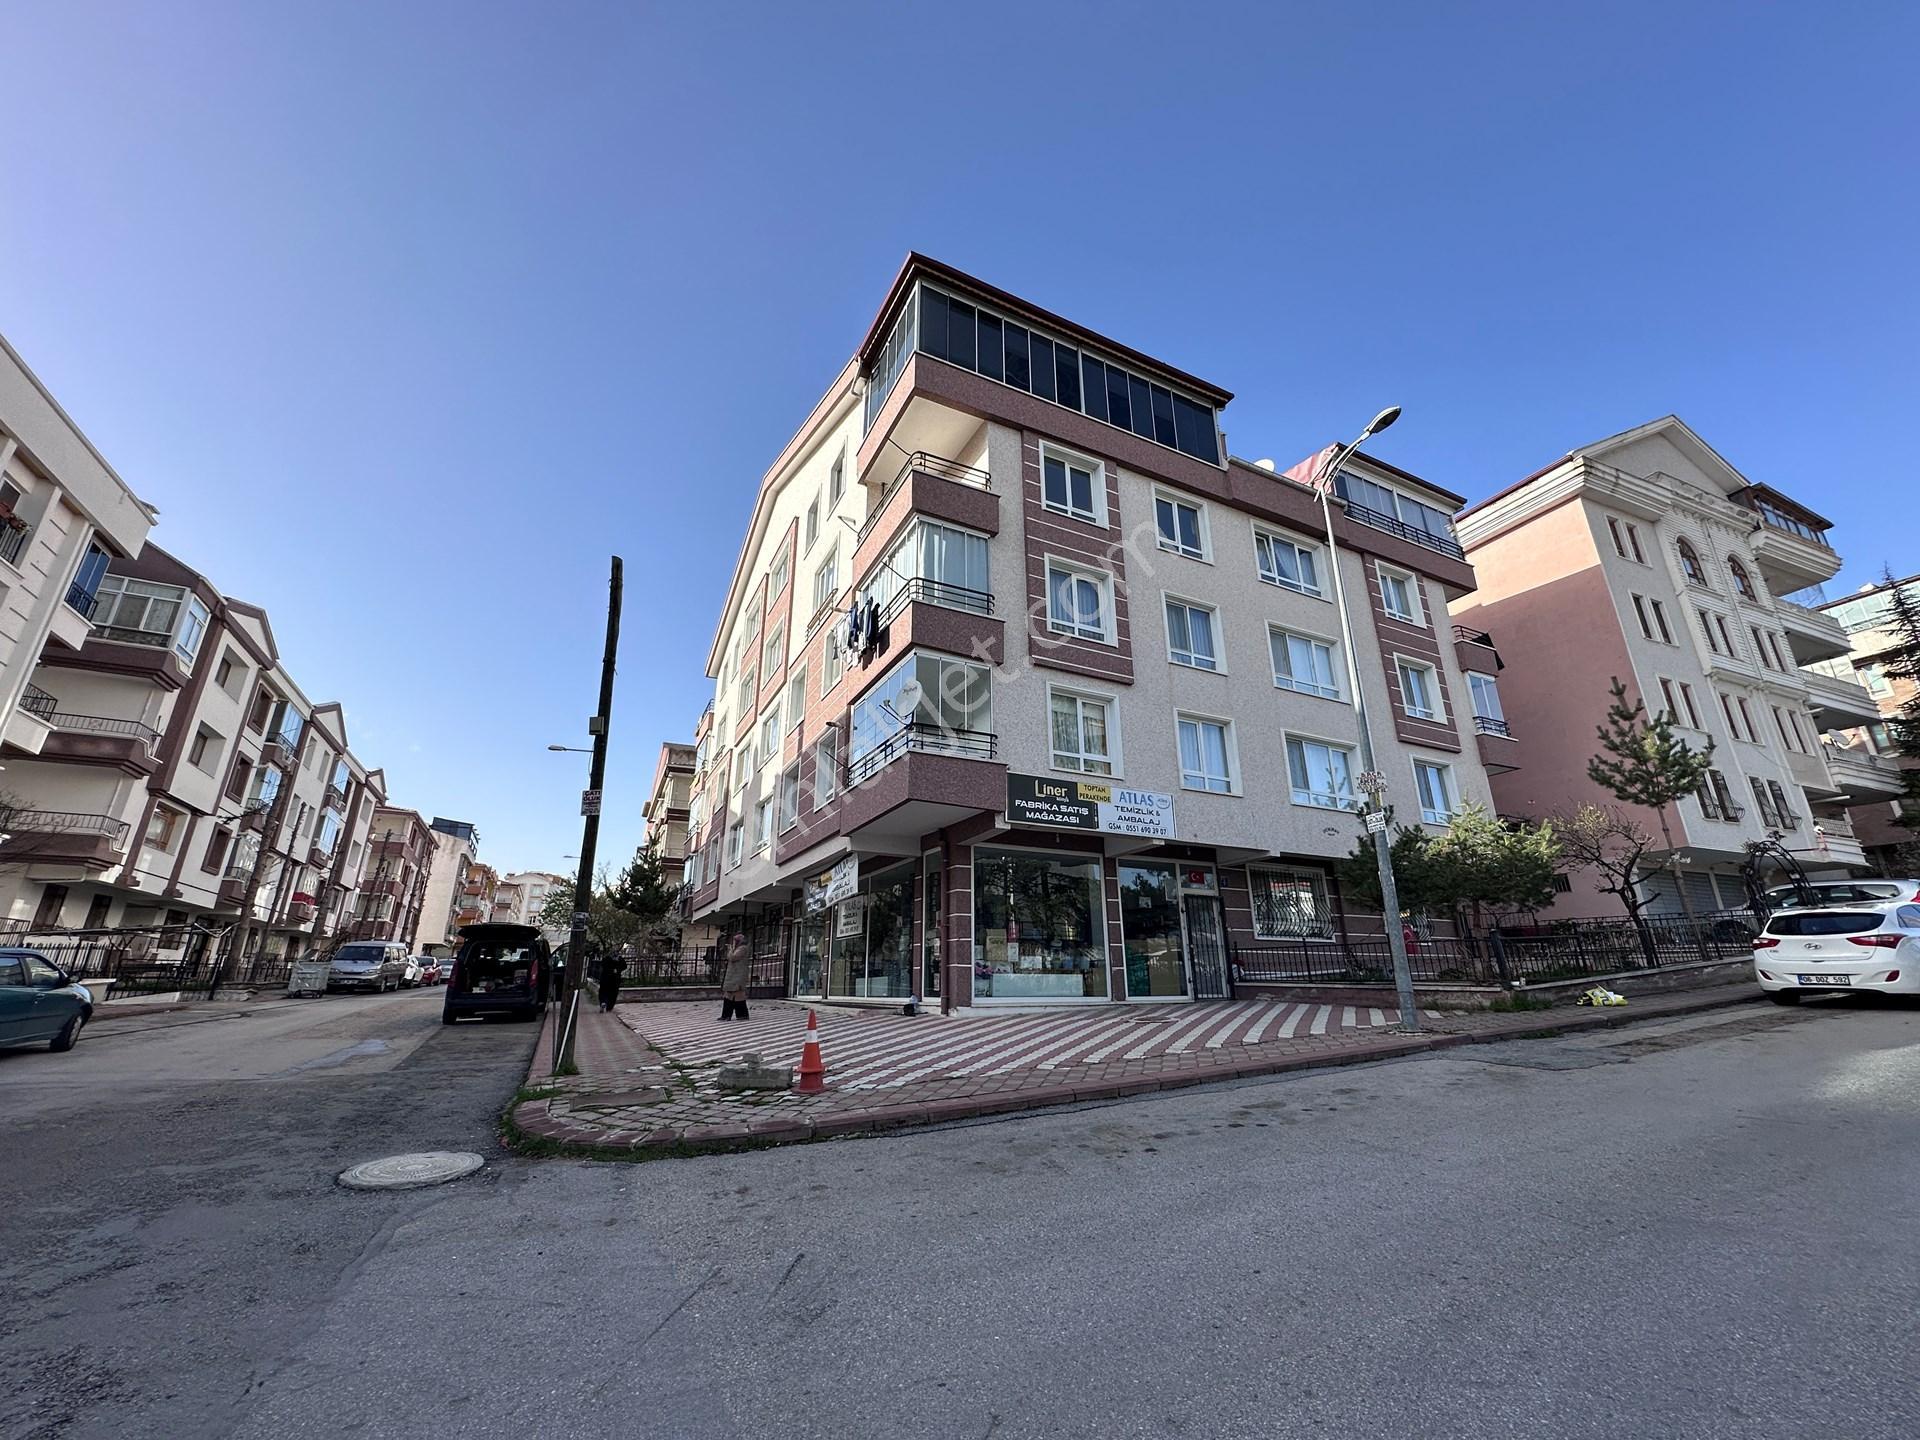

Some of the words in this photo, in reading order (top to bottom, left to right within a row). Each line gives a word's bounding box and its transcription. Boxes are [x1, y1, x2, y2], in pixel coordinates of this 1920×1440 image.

[1034, 779, 1068, 798] Liner
[1083, 784, 1106, 793] TOPTAN
[1079, 792, 1112, 803] PERAKENDE
[1118, 791, 1154, 807] ATLAS
[1015, 799, 1059, 812] FABRİKA
[1060, 805, 1089, 816] SATIŞ
[1114, 805, 1155, 817] TEMİZLİK
[1026, 810, 1080, 824] MAĞAZASI
[1117, 815, 1161, 826] AMBALAJ
[1125, 824, 1139, 833] 0551
[1141, 826, 1151, 834] 690
[1152, 827, 1159, 835] 39
[1160, 828, 1167, 836] 07
